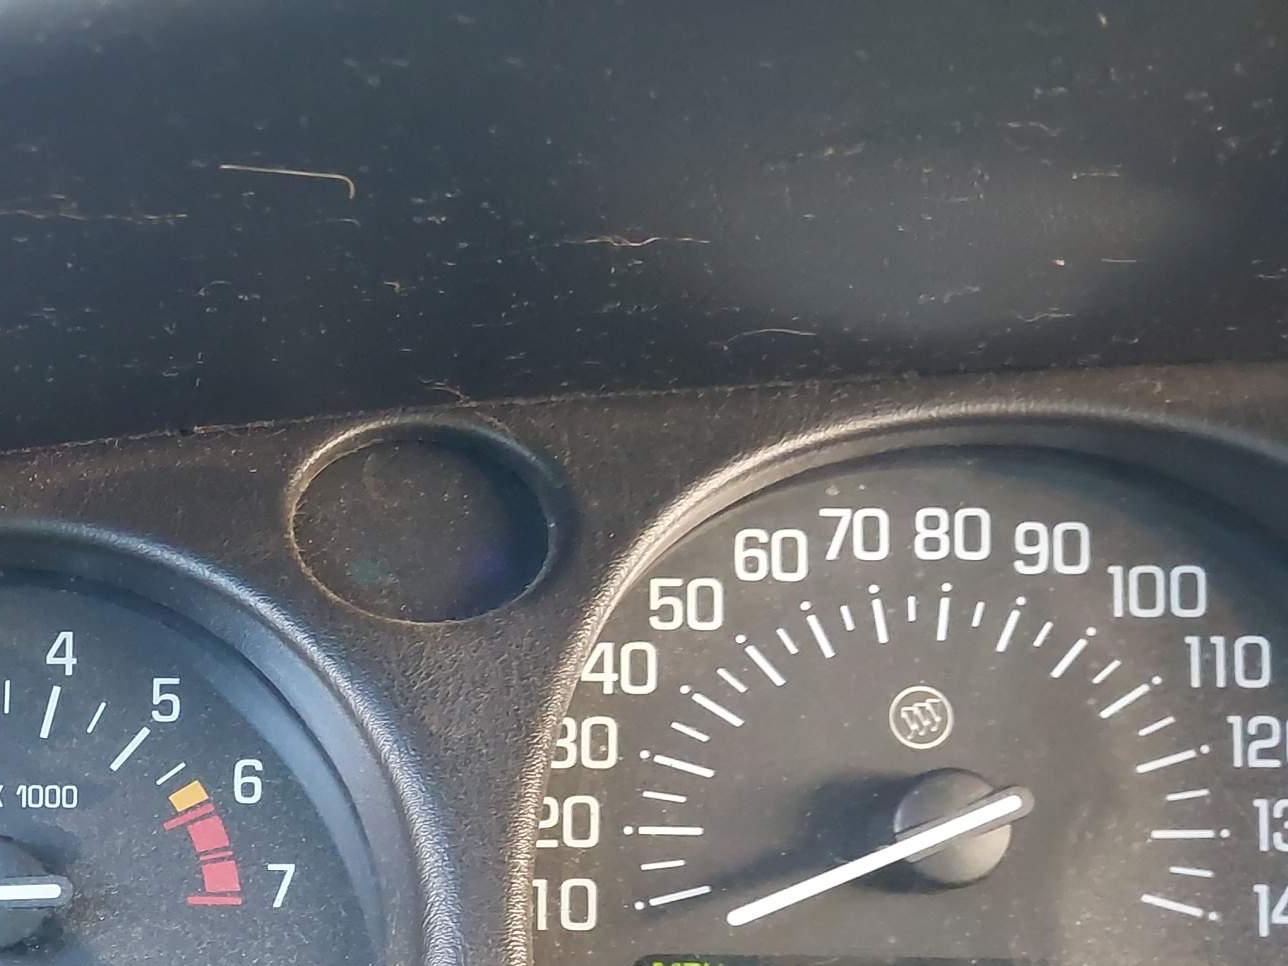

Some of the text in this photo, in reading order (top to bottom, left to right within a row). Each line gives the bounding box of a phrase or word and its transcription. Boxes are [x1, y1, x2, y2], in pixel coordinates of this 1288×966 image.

[734, 528, 809, 582] 60
[819, 507, 890, 561] 70
[913, 507, 991, 561] 80
[1013, 521, 1090, 575] 90
[649, 577, 724, 631] 50
[1107, 565, 1207, 618] 100
[46, 631, 78, 676] 4
[580, 641, 658, 695] 40
[1184, 635, 1271, 689] 110
[151, 677, 181, 723] 5
[550, 716, 618, 769] 30
[1227, 715, 1288, 768] 12
[15, 784, 78, 809] 1000
[233, 758, 264, 804] 6
[267, 863, 296, 908] 7
[532, 878, 597, 931] 10
